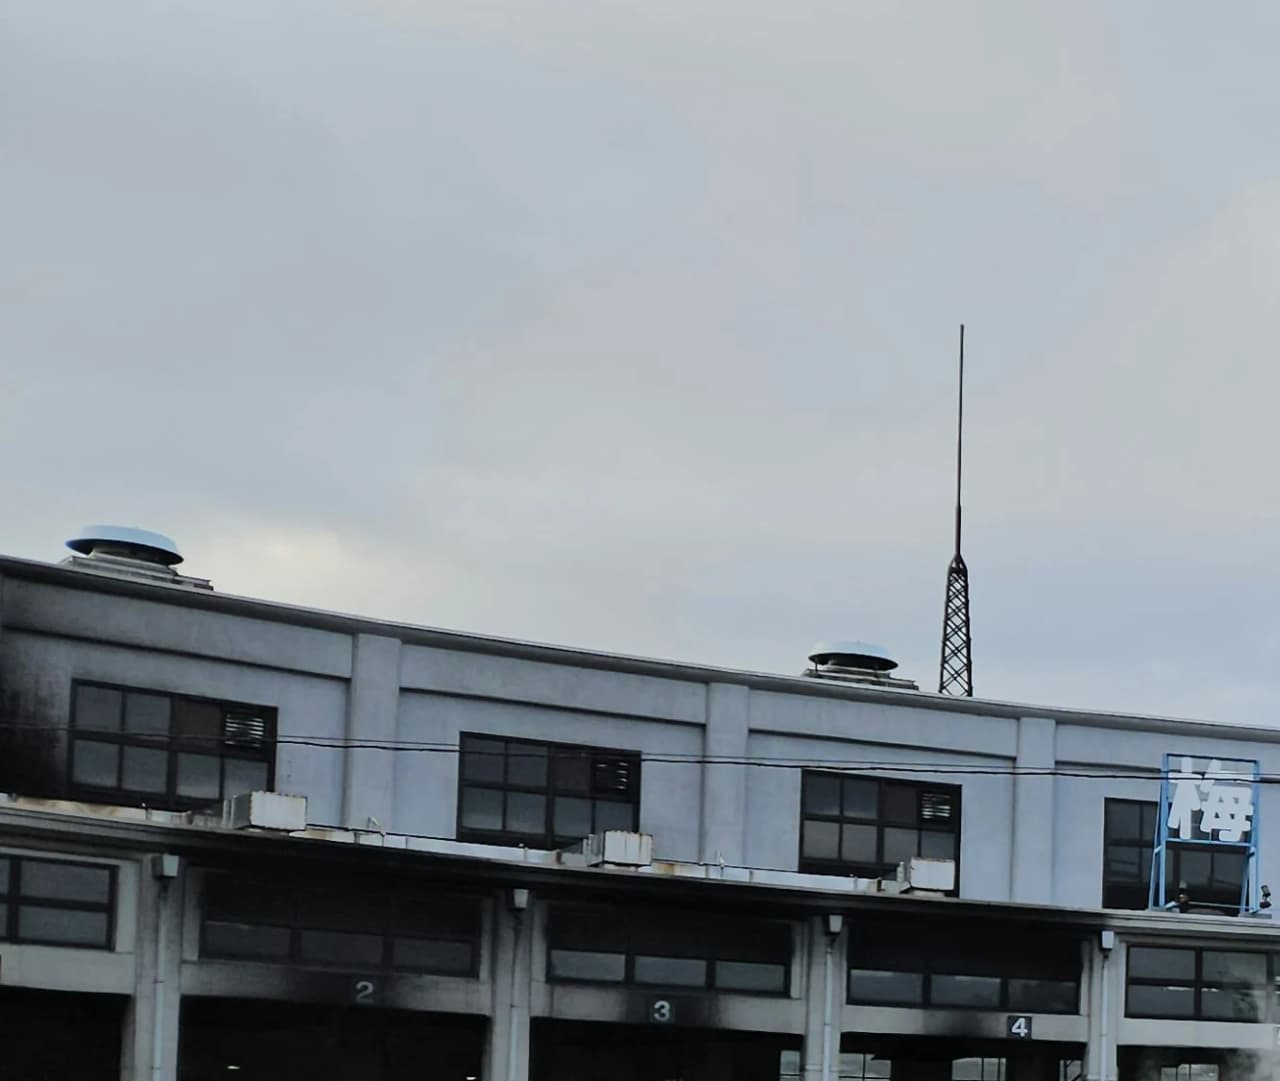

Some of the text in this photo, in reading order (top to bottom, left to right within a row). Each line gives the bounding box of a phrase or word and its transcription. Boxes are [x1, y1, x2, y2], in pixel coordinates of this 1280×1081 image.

[356, 981, 373, 1002] 2
[654, 1001, 670, 1021] 3
[1011, 1017, 1028, 1037] 4
